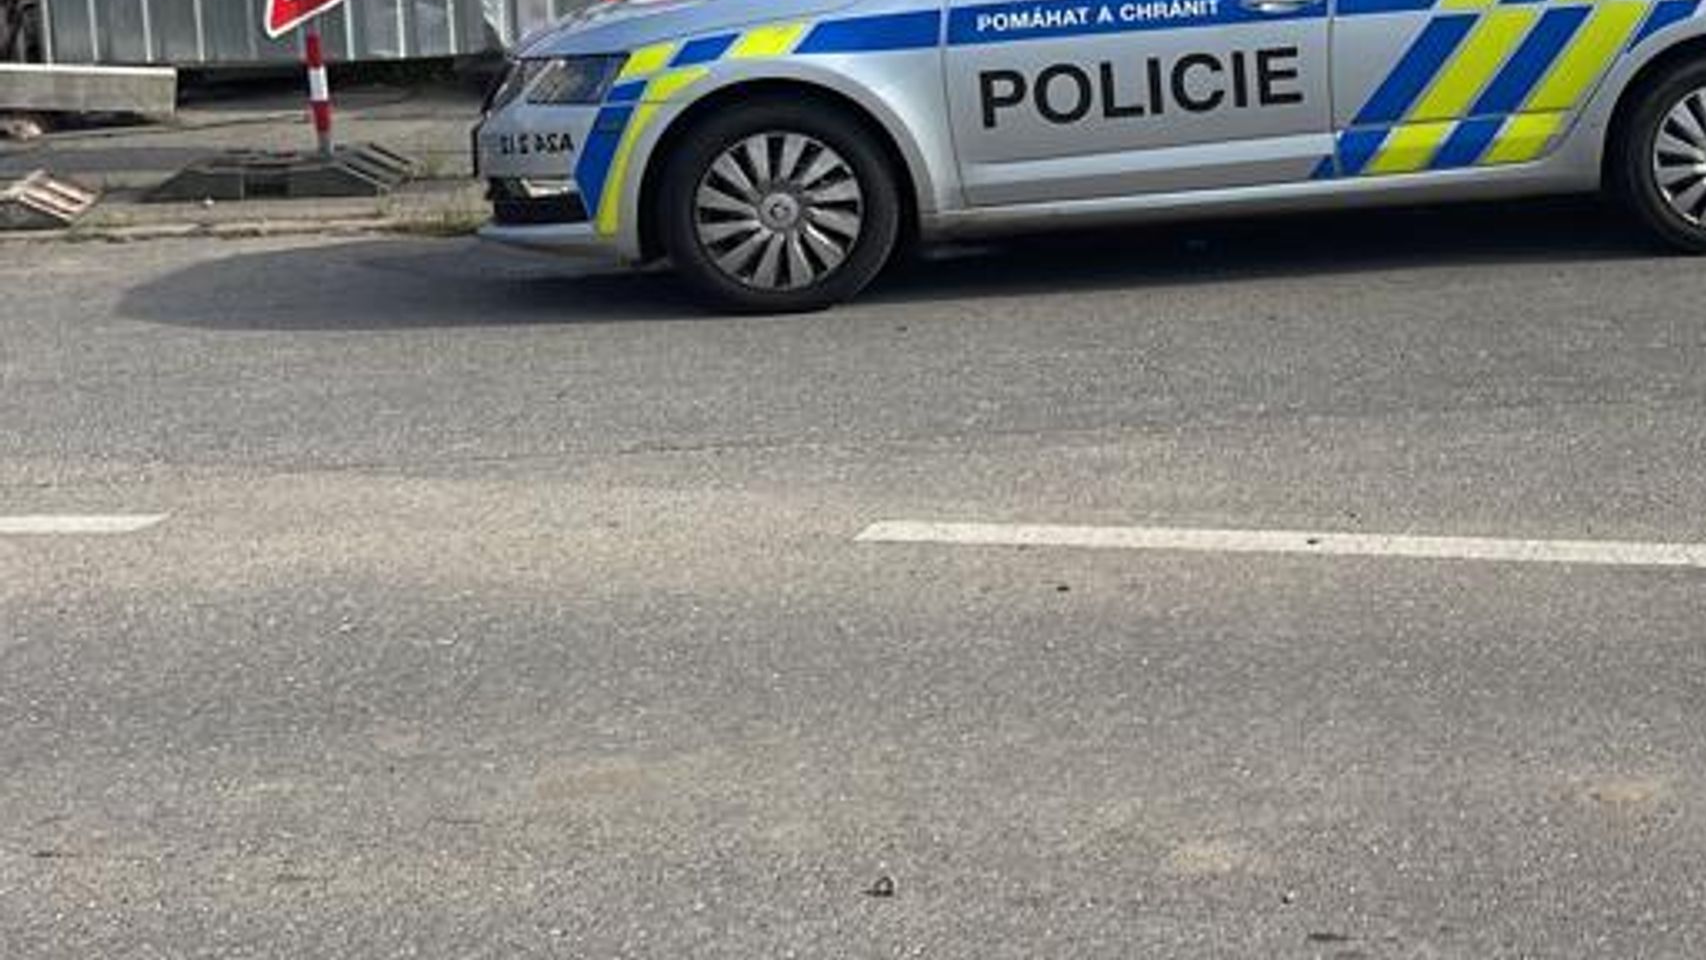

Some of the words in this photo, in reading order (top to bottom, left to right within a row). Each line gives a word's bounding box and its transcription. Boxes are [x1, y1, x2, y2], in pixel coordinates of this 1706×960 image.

[976, 5, 1090, 32] POMÁHAT
[1096, 4, 1114, 22] A
[978, 46, 1304, 130] POLICIE
